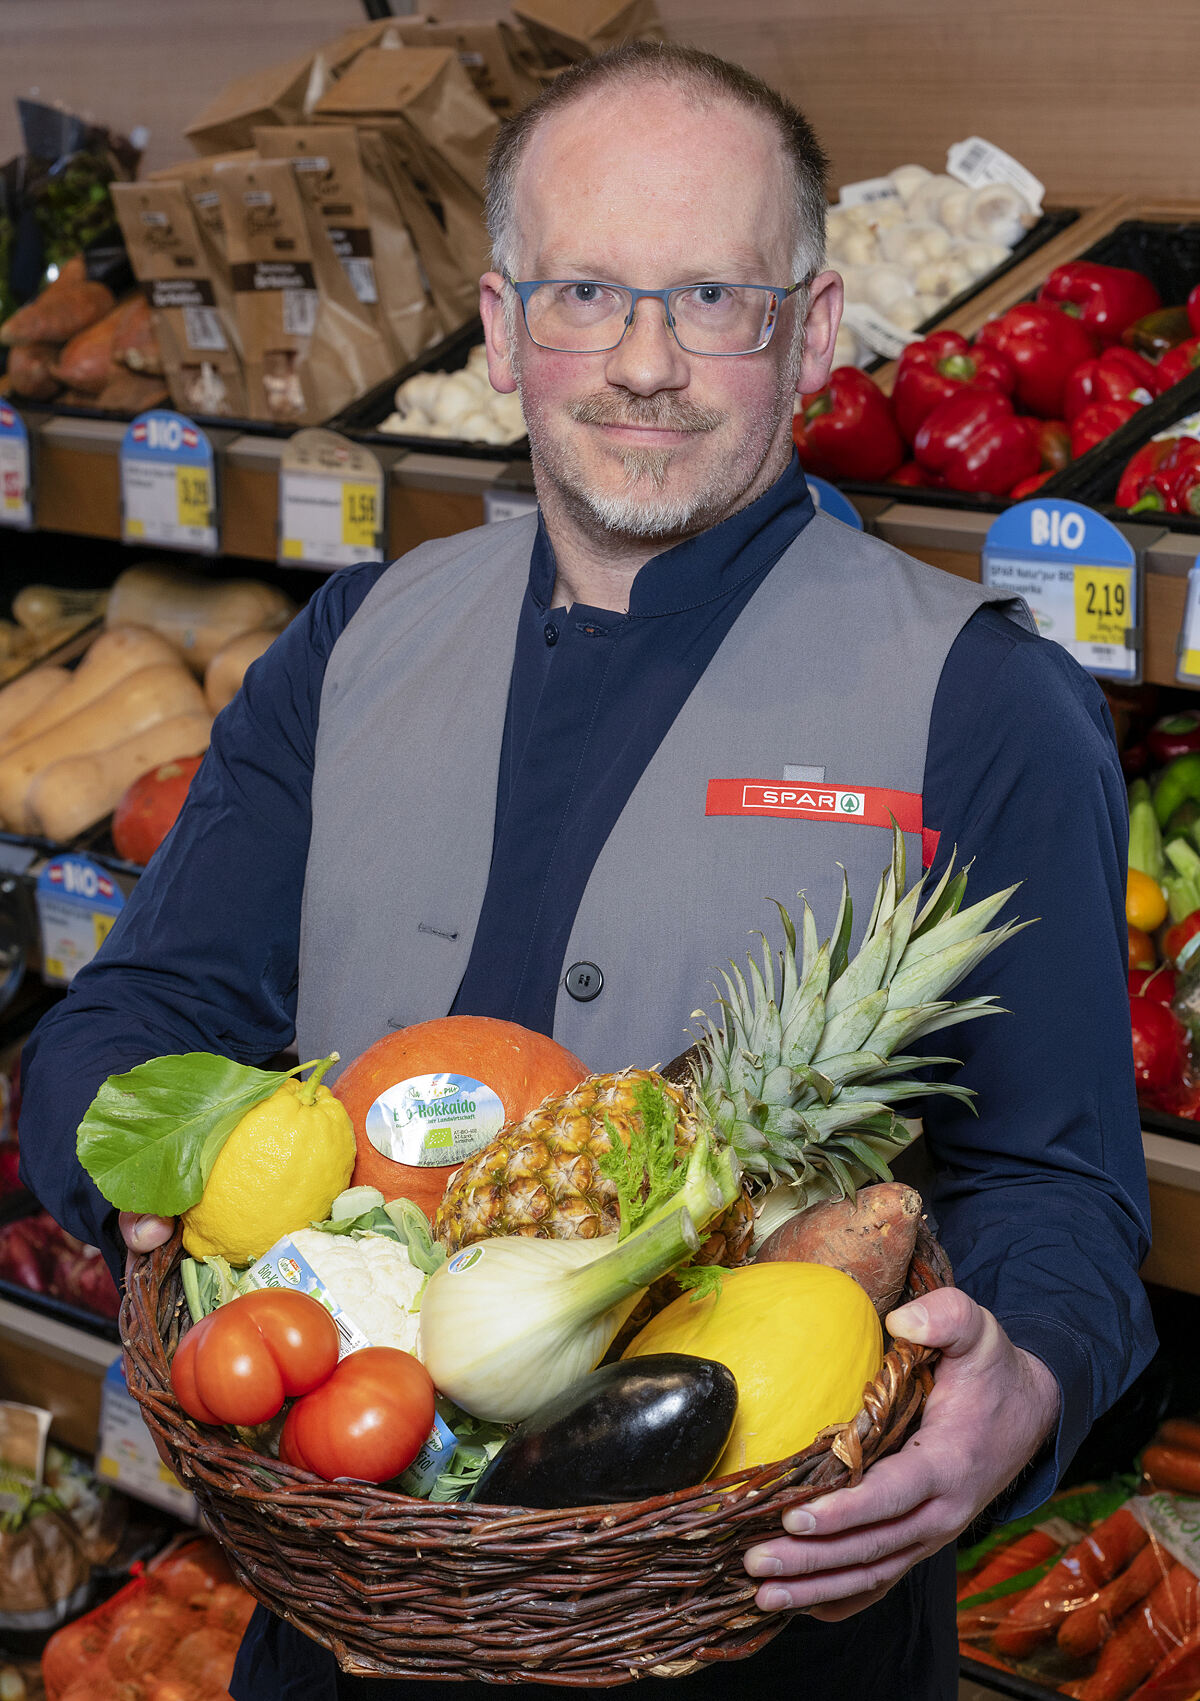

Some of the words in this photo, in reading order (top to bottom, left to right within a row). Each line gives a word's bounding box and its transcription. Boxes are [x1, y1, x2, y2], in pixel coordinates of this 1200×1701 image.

[1031, 508, 1086, 550] BIO
[1086, 582, 1125, 621] 2,19
[763, 791, 834, 808] SPAR
[393, 1099, 477, 1122] Bo-Hokkaido
